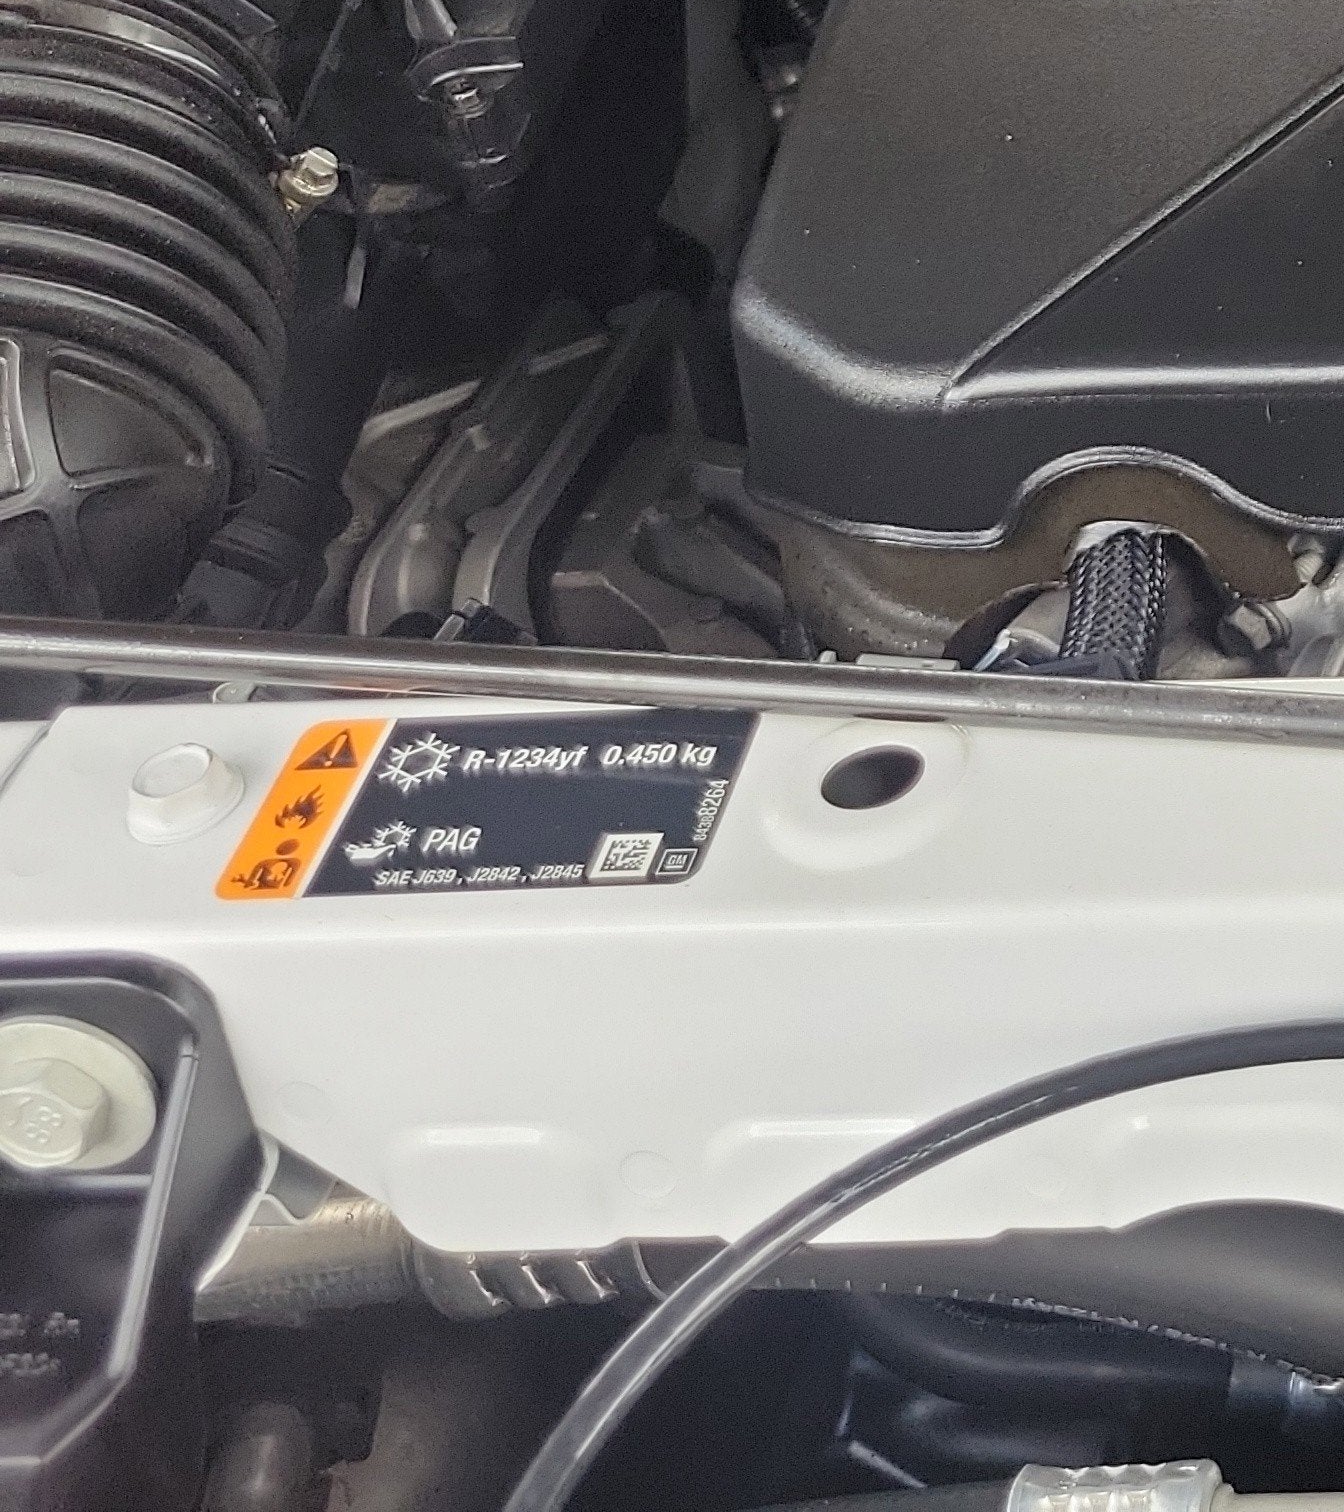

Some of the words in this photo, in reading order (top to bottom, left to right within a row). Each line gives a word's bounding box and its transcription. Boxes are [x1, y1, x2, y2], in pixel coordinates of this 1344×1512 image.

[463, 745, 589, 772] R-1234yf
[602, 743, 677, 766] 0.450
[681, 742, 718, 767] kg
[422, 827, 482, 852] PAG
[666, 853, 688, 865] GM
[375, 869, 413, 886] SAE
[532, 864, 585, 881] J2845
